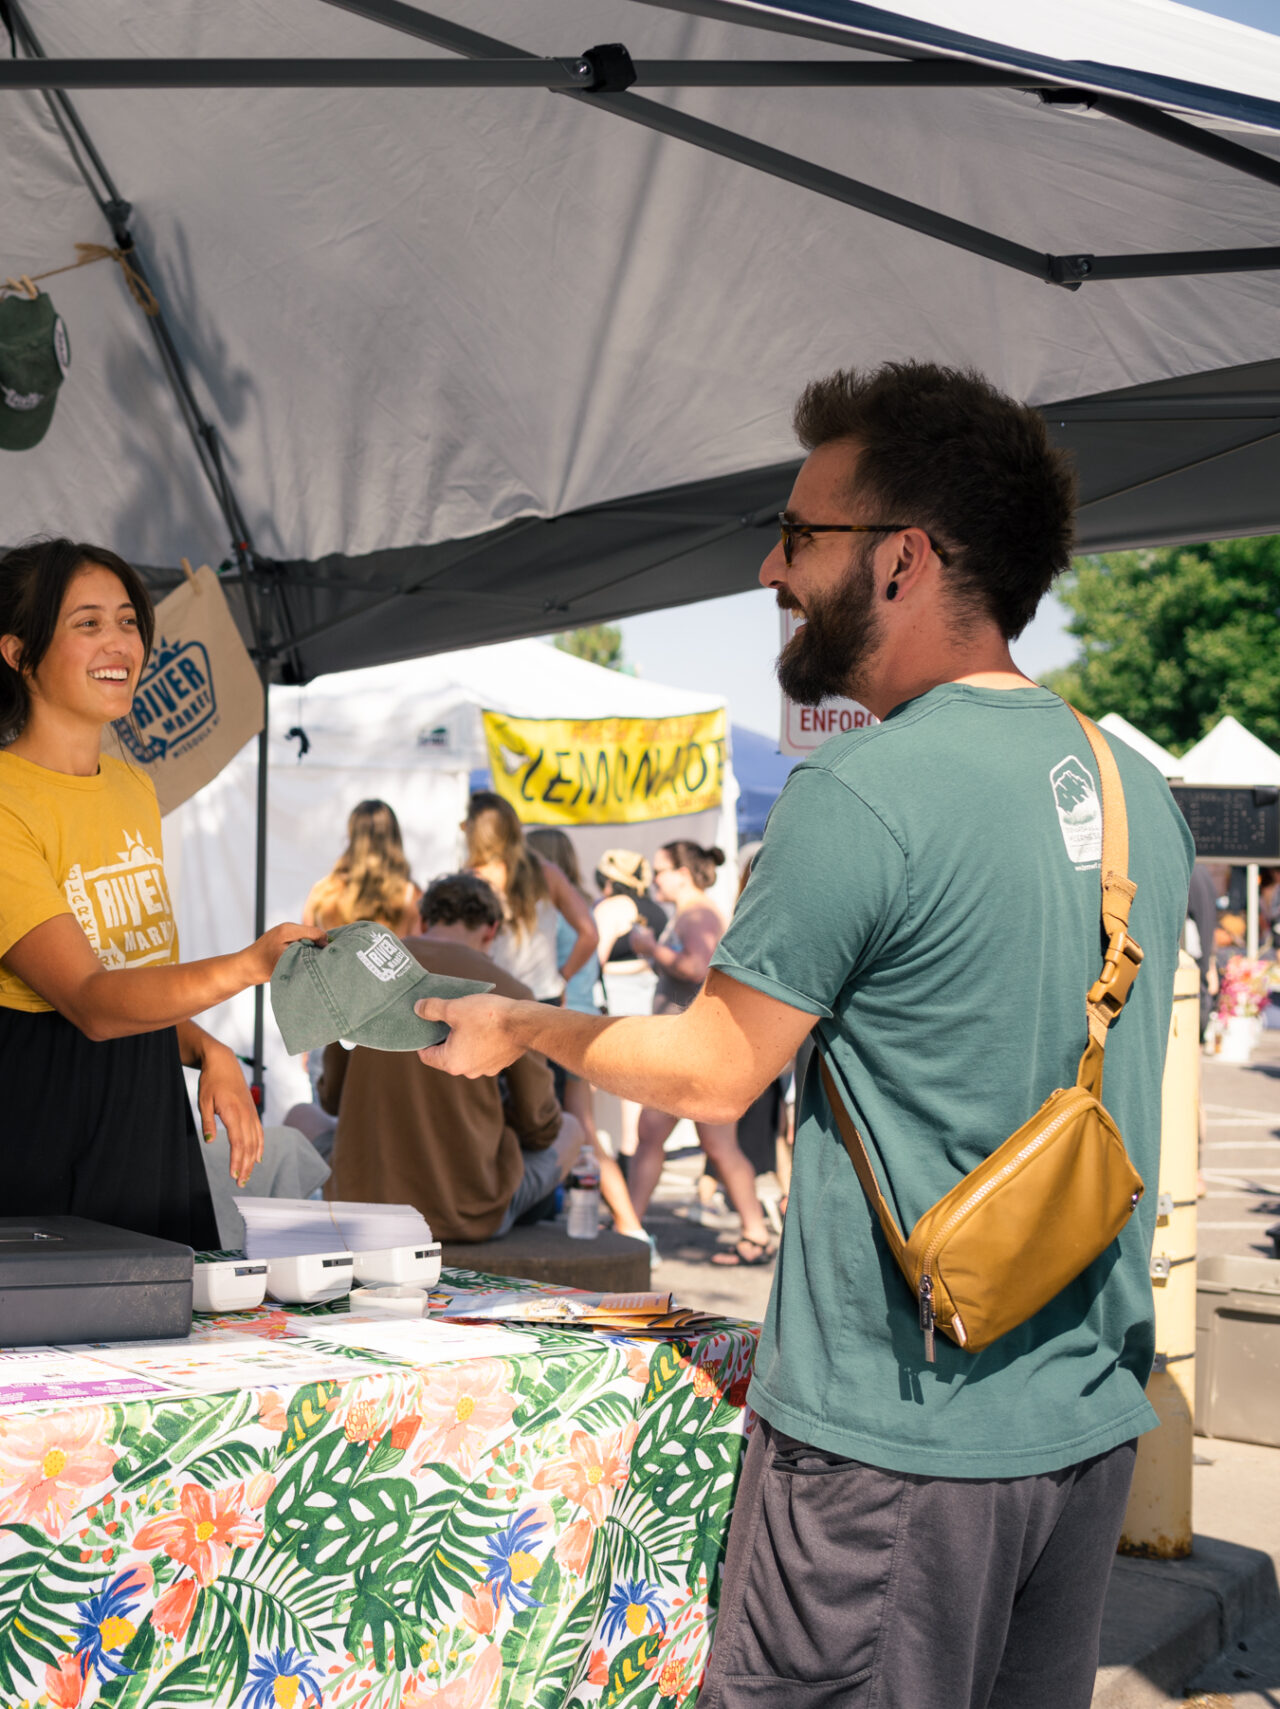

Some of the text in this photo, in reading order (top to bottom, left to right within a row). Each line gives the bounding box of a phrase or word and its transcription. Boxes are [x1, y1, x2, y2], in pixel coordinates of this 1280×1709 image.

[132, 657, 206, 730] RIVER
[124, 920, 174, 953] MARK
[368, 938, 398, 968] RIVER
